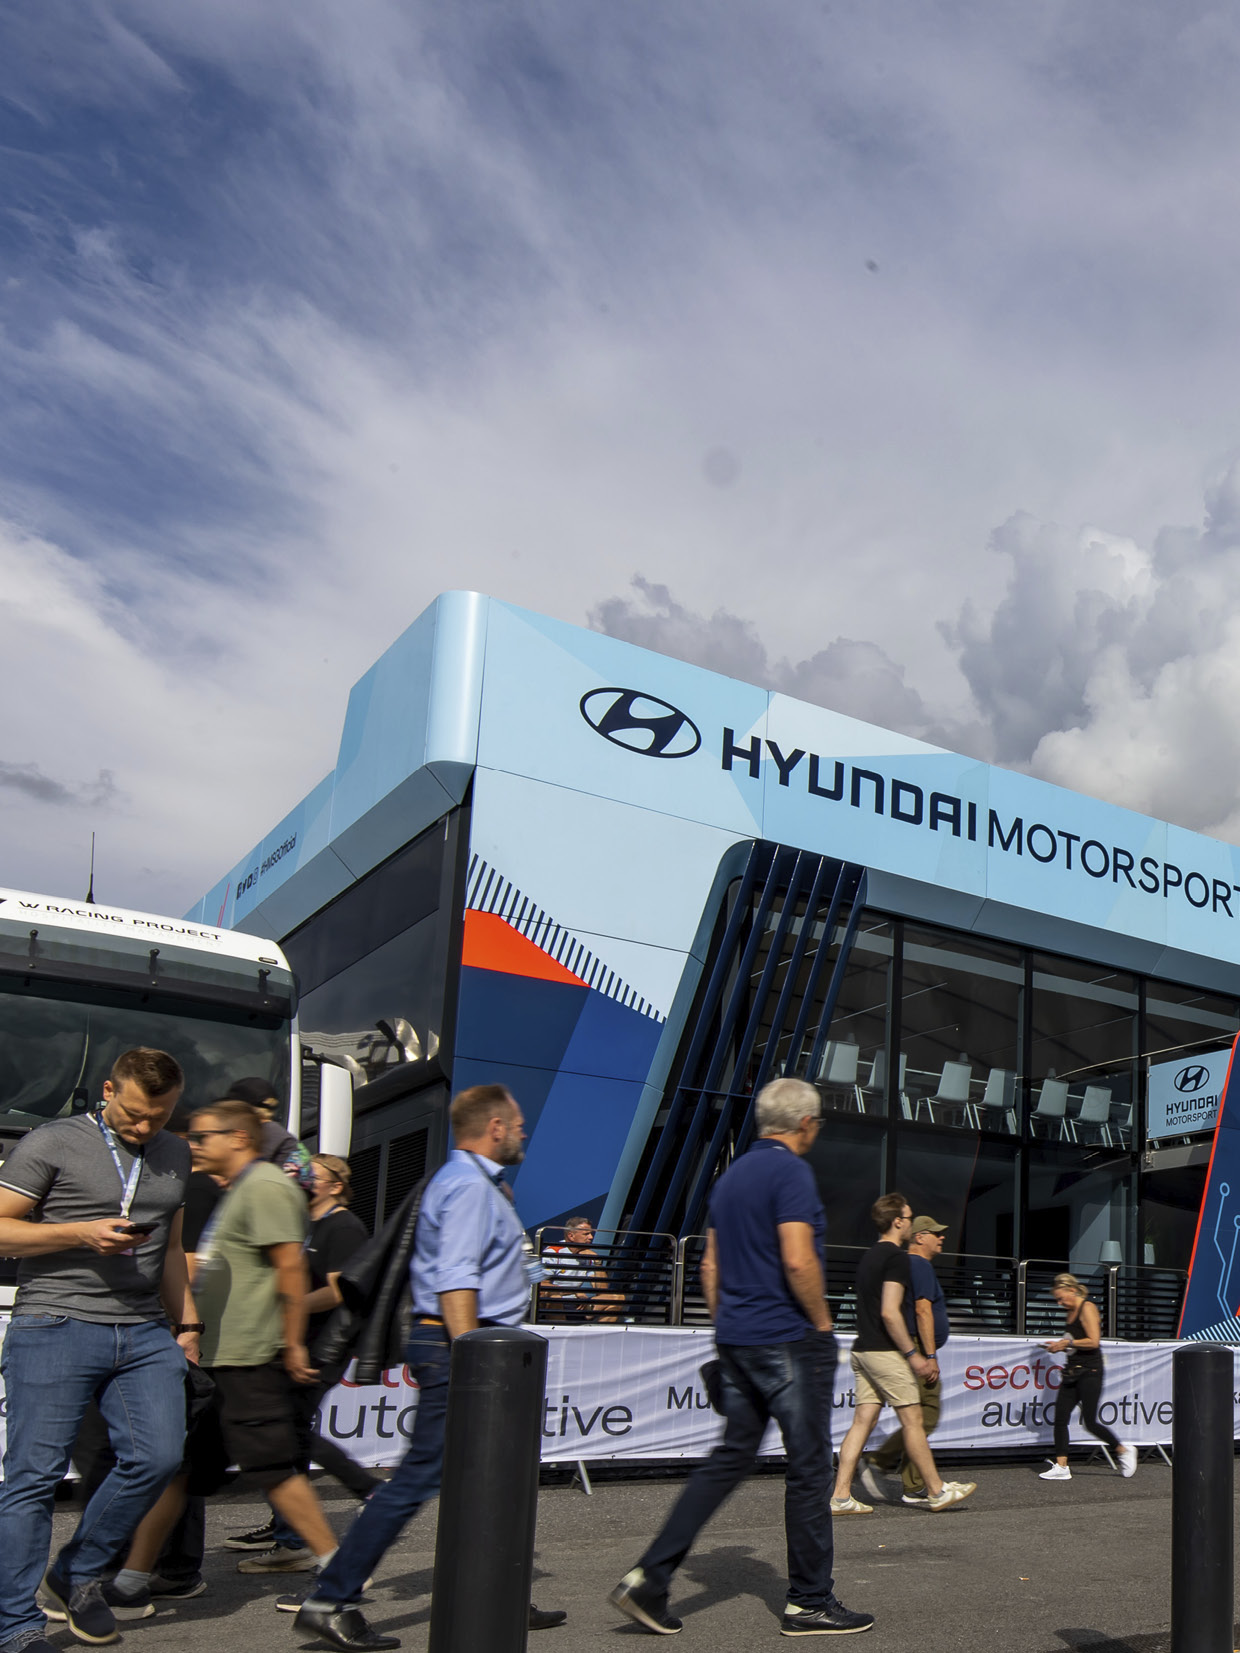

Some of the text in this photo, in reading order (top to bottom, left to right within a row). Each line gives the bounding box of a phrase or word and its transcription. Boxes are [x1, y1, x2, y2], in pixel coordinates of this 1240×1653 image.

[722, 727, 976, 841] HYUNDAI
[46, 905, 124, 923] RACING
[132, 919, 222, 941] PROJECT
[1166, 1095, 1218, 1115] HYUNDAI
[1166, 1110, 1218, 1127] MOTORSPORT
[963, 1358, 1065, 1390] secto
[981, 1394, 1174, 1427] autootive
